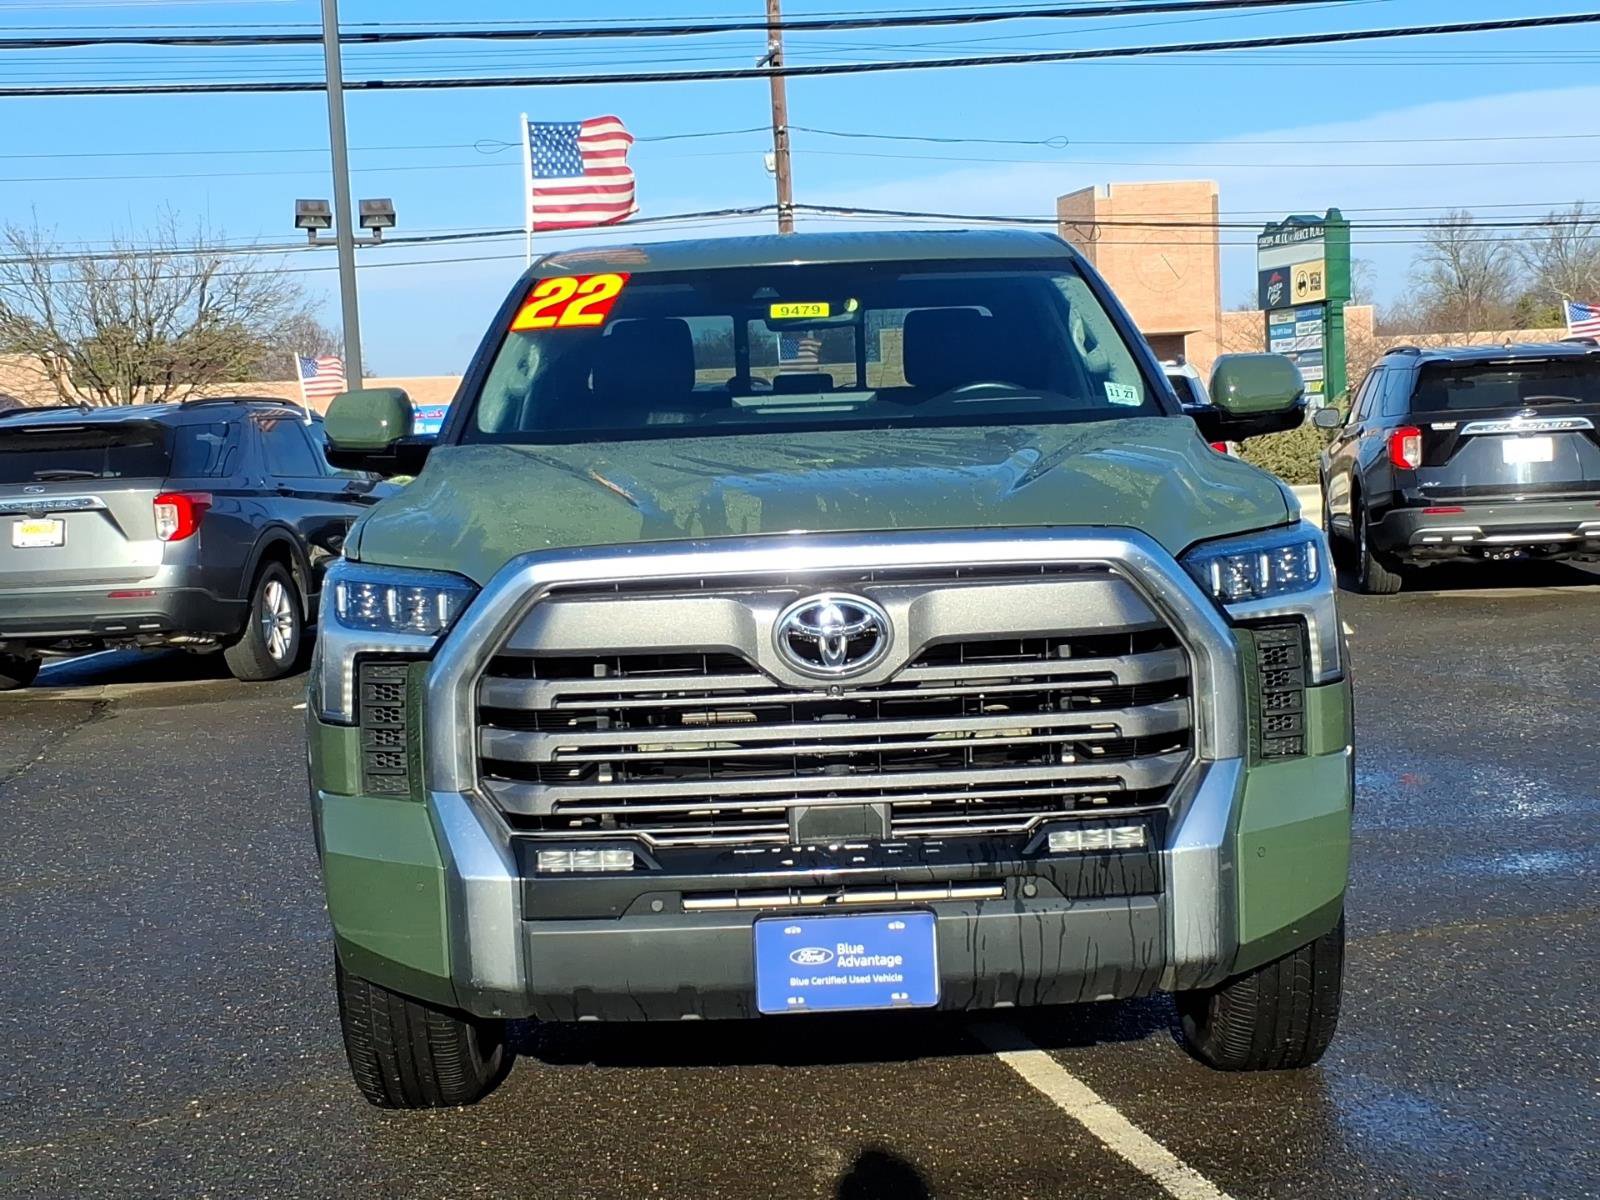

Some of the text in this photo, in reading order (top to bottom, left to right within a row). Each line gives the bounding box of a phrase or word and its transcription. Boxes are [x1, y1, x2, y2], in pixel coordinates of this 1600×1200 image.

[512, 273, 624, 330] 22
[780, 304, 821, 316] 9479
[837, 942, 865, 955] Blue
[837, 954, 903, 968] Advantage
[790, 973, 903, 986] Blue Certified Used Vehicle
